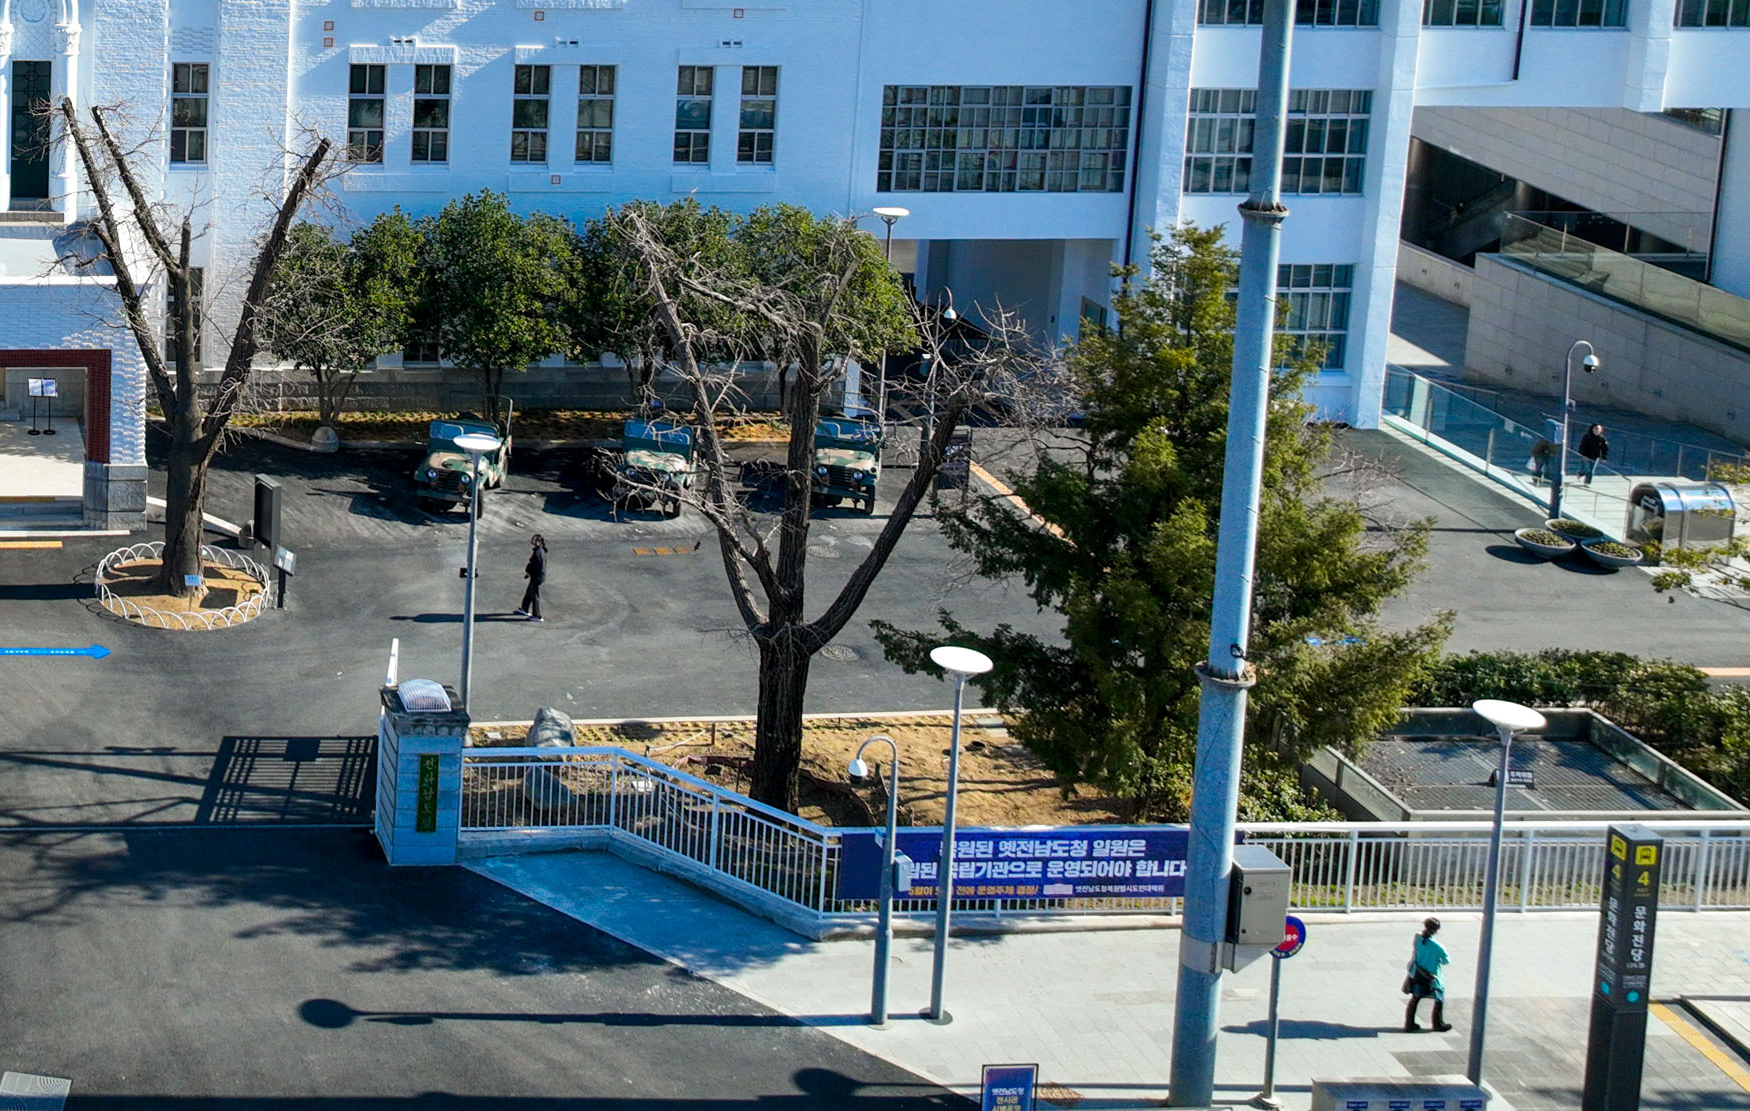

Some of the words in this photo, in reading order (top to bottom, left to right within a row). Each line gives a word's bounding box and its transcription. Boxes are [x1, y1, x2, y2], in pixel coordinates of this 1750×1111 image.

[997, 839, 1088, 858] 옛전남도청
[1092, 839, 1147, 857] 일원은
[1046, 860, 1133, 878] 운영되어야
[1611, 863, 1623, 880] 4
[1637, 870, 1650, 887] 4
[1631, 905, 1648, 963] 문화전당
